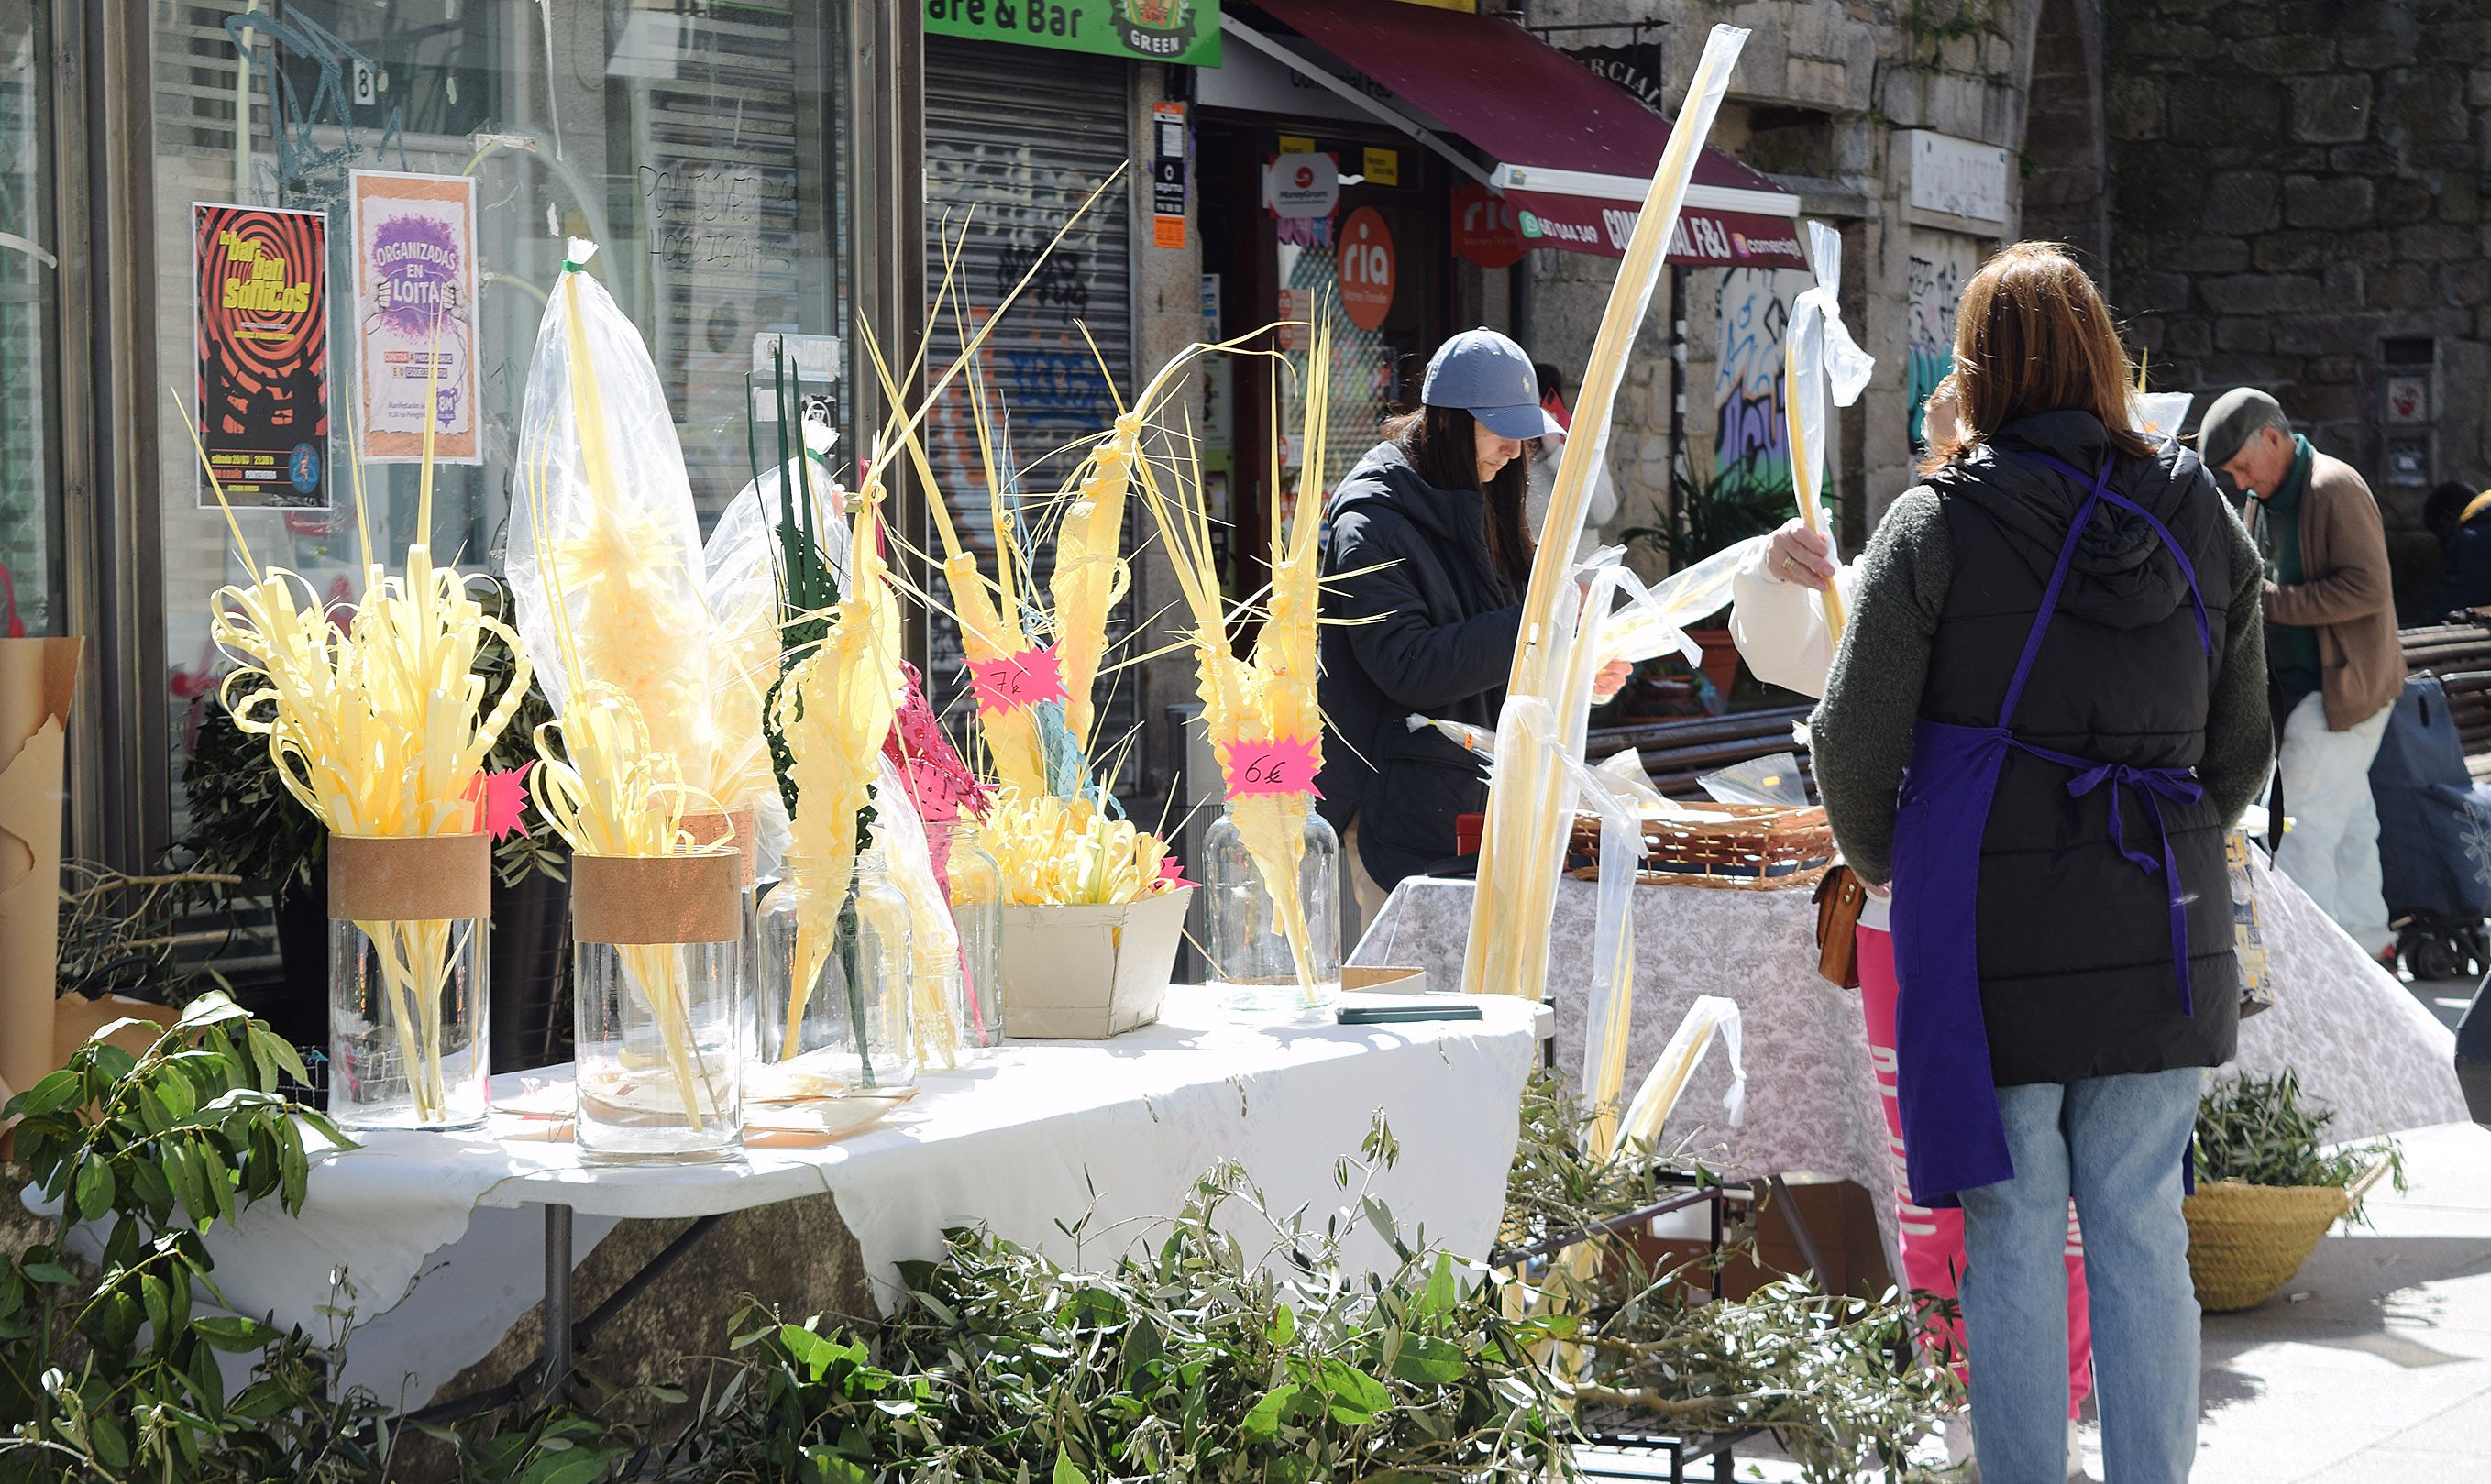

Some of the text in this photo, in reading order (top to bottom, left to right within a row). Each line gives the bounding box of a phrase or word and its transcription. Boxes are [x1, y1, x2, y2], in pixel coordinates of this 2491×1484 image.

[994, 0, 1017, 29] &
[1026, 0, 1083, 38] Bar
[1130, 29, 1180, 52] GREEN
[1279, 190, 1328, 201] MoneyGram
[1690, 217, 1732, 259] F&J
[376, 241, 457, 271] ORGANIZADAS
[1344, 223, 1389, 286] ria
[406, 264, 424, 278] EN
[393, 278, 440, 304] LOITA
[439, 396, 454, 412] 8M
[1245, 754, 1286, 785] 6€
